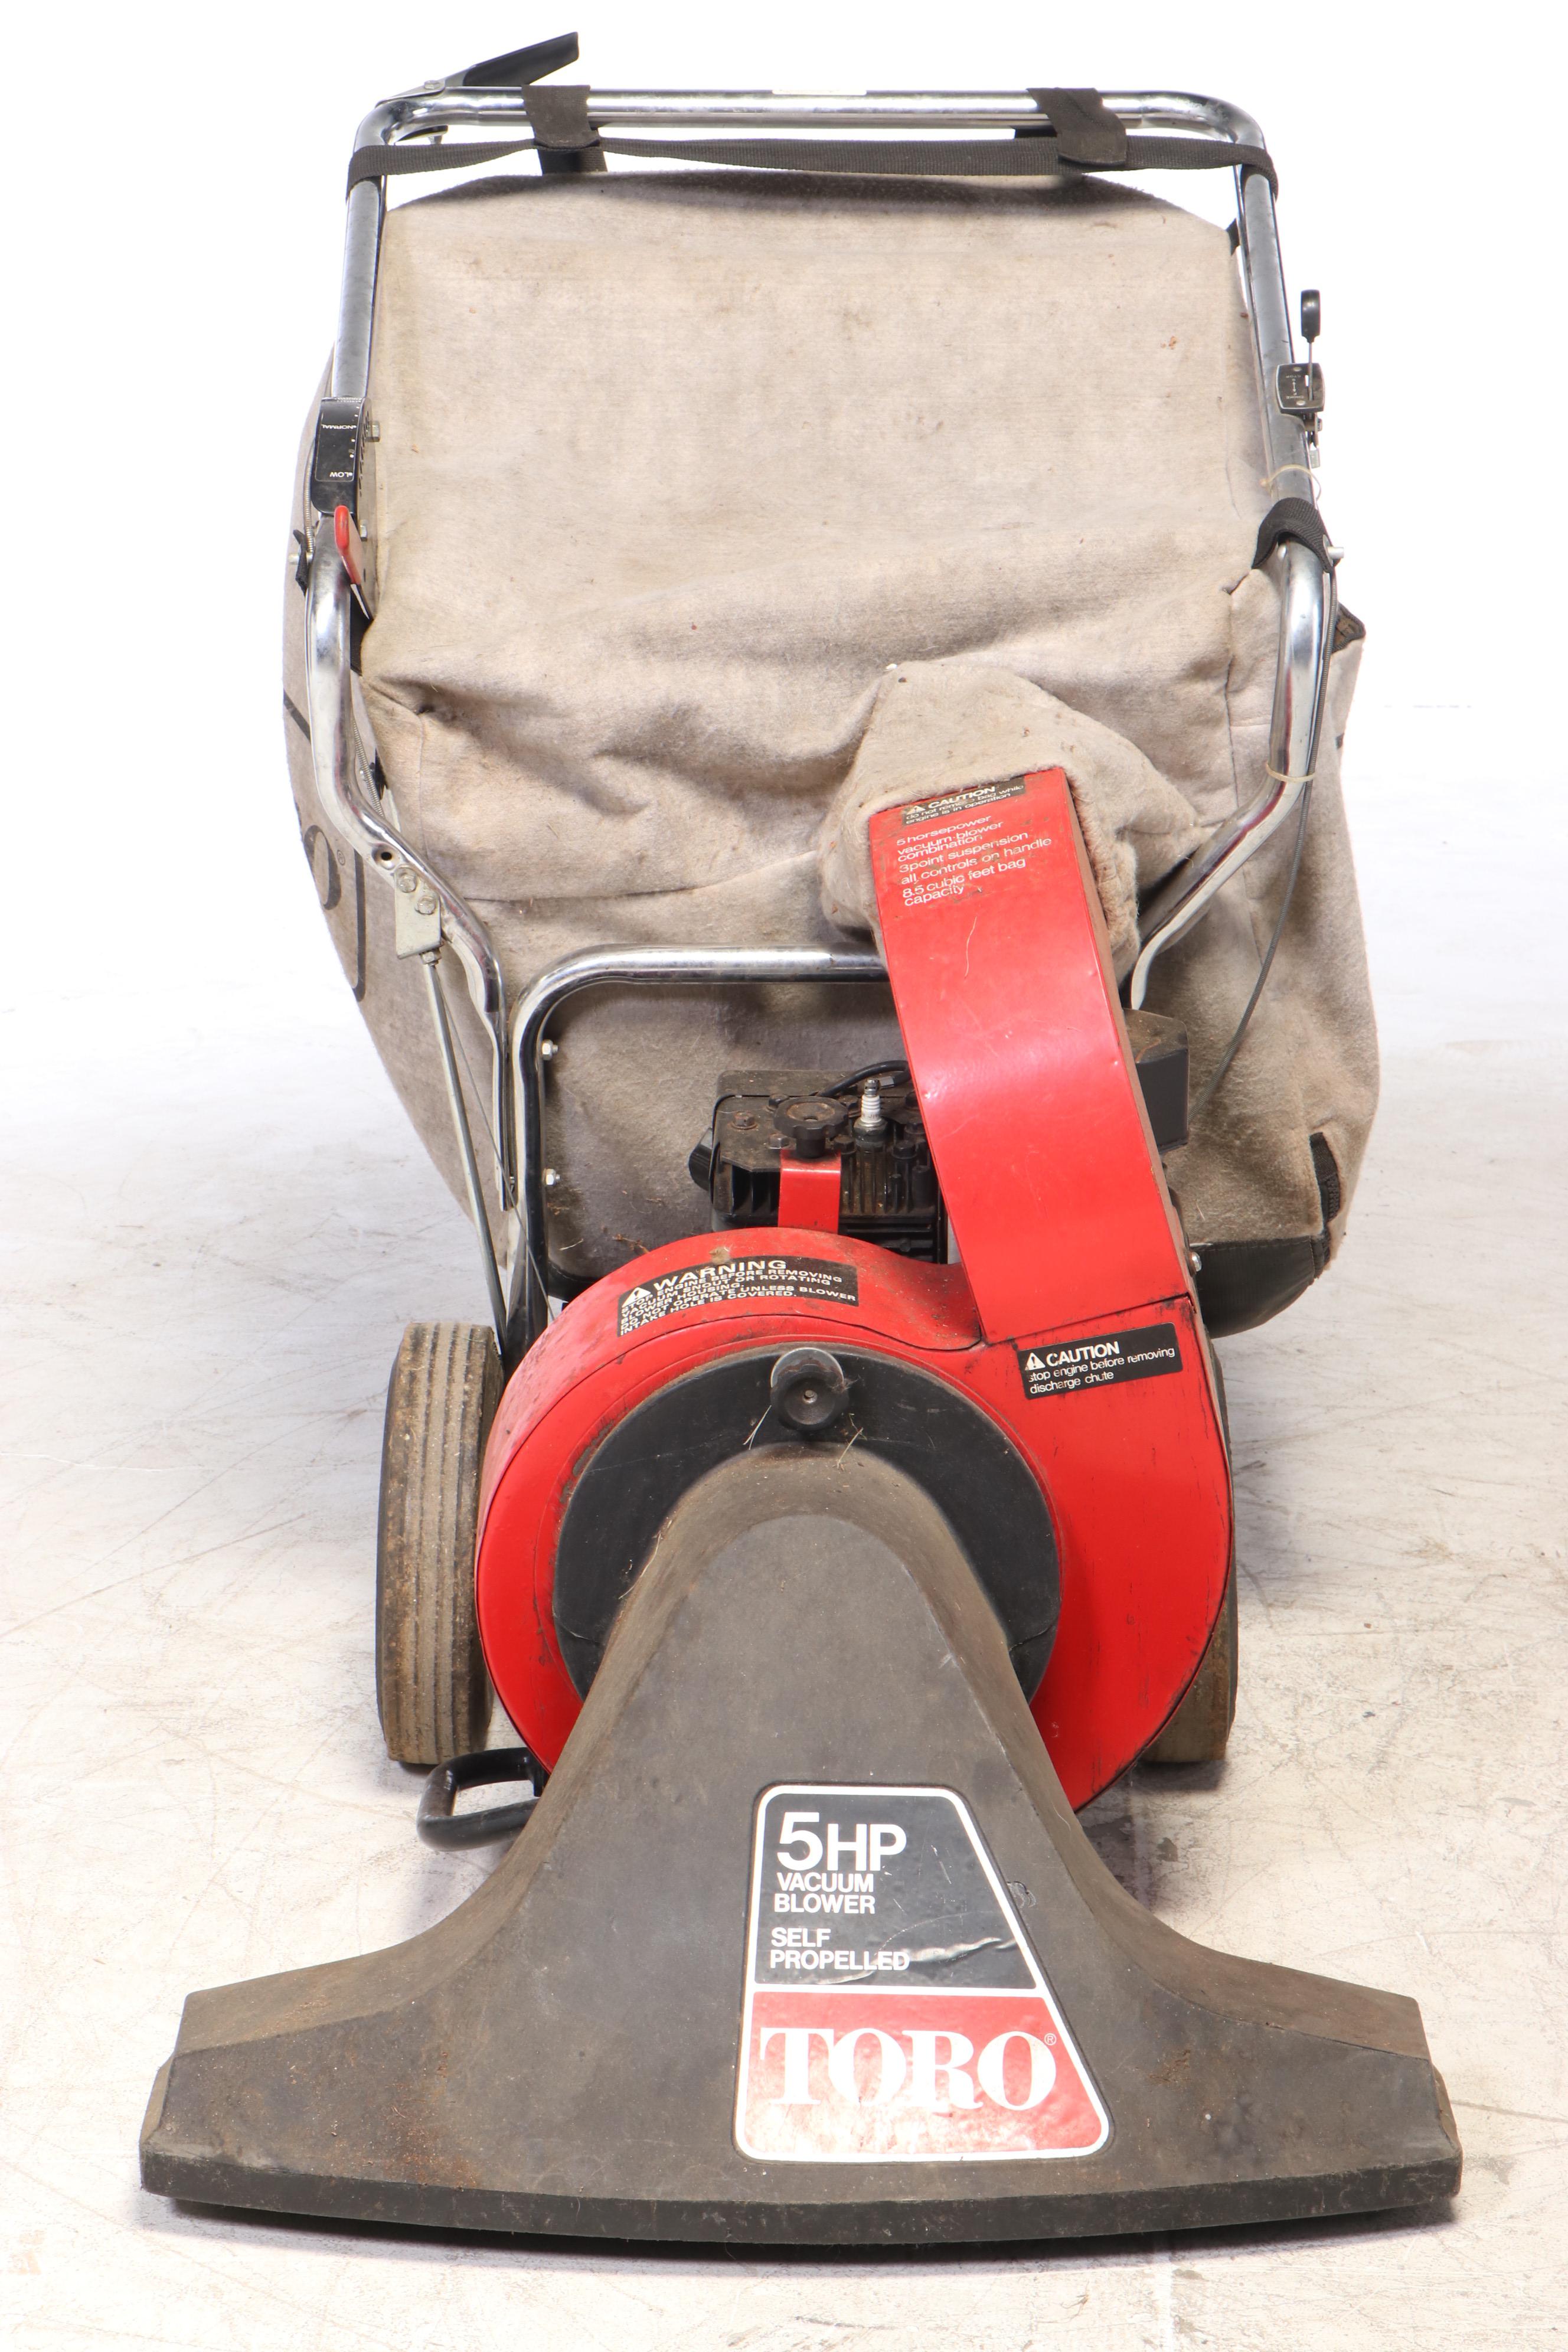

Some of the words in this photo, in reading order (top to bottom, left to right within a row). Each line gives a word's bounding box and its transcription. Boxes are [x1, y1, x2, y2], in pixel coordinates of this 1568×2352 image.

[928, 786, 995, 809] CAUTION
[978, 792, 997, 801] bag
[999, 785, 1024, 795] while
[906, 812, 939, 825] engine
[965, 793, 1011, 809] operation
[897, 838, 906, 846] 5
[907, 815, 992, 844] horsepower
[948, 831, 1029, 860] suspension
[897, 834, 984, 863] combination
[901, 873, 917, 885] all
[921, 858, 978, 880] controls
[982, 851, 1000, 863] on
[1004, 837, 1052, 857] handle
[902, 885, 925, 898] 8.5
[926, 874, 965, 892] cubic
[968, 864, 995, 880] feet
[998, 858, 1027, 873] bag
[904, 886, 965, 907] capacity
[653, 1260, 787, 1291] WARNING
[621, 1297, 672, 1325] BLOWER
[677, 1283, 745, 1301] HOUSING.
[622, 1293, 654, 1314] STOP
[656, 1278, 707, 1296] ENGINE
[711, 1270, 763, 1282] BEFORE
[768, 1269, 842, 1283] REMOVING
[622, 1291, 678, 1318] VACUUM
[683, 1279, 731, 1293] SNOUT
[760, 1275, 831, 1286] ROTATING
[620, 1317, 639, 1330] DO
[642, 1304, 670, 1319] NOT
[672, 1288, 736, 1307] OPERATE
[799, 1286, 857, 1302] BLOWER
[620, 1311, 667, 1337] INTAKE
[669, 1300, 705, 1314] HOLE
[727, 1290, 797, 1300] COVERED.
[1028, 1370, 1051, 1383] stop
[1053, 1363, 1089, 1377] engine
[1091, 1357, 1125, 1371] before
[1127, 1347, 1176, 1364] removing
[1046, 1341, 1120, 1367] CAUTION
[1030, 1377, 1082, 1395] discharge
[1084, 1370, 1115, 1384] chute
[776, 1811, 907, 1872] 5HP
[776, 1872, 874, 1893] VACUUM
[773, 1893, 876, 1915] BLOWER
[770, 1927, 831, 1948] SELF
[770, 1950, 910, 1971] PROPELLED
